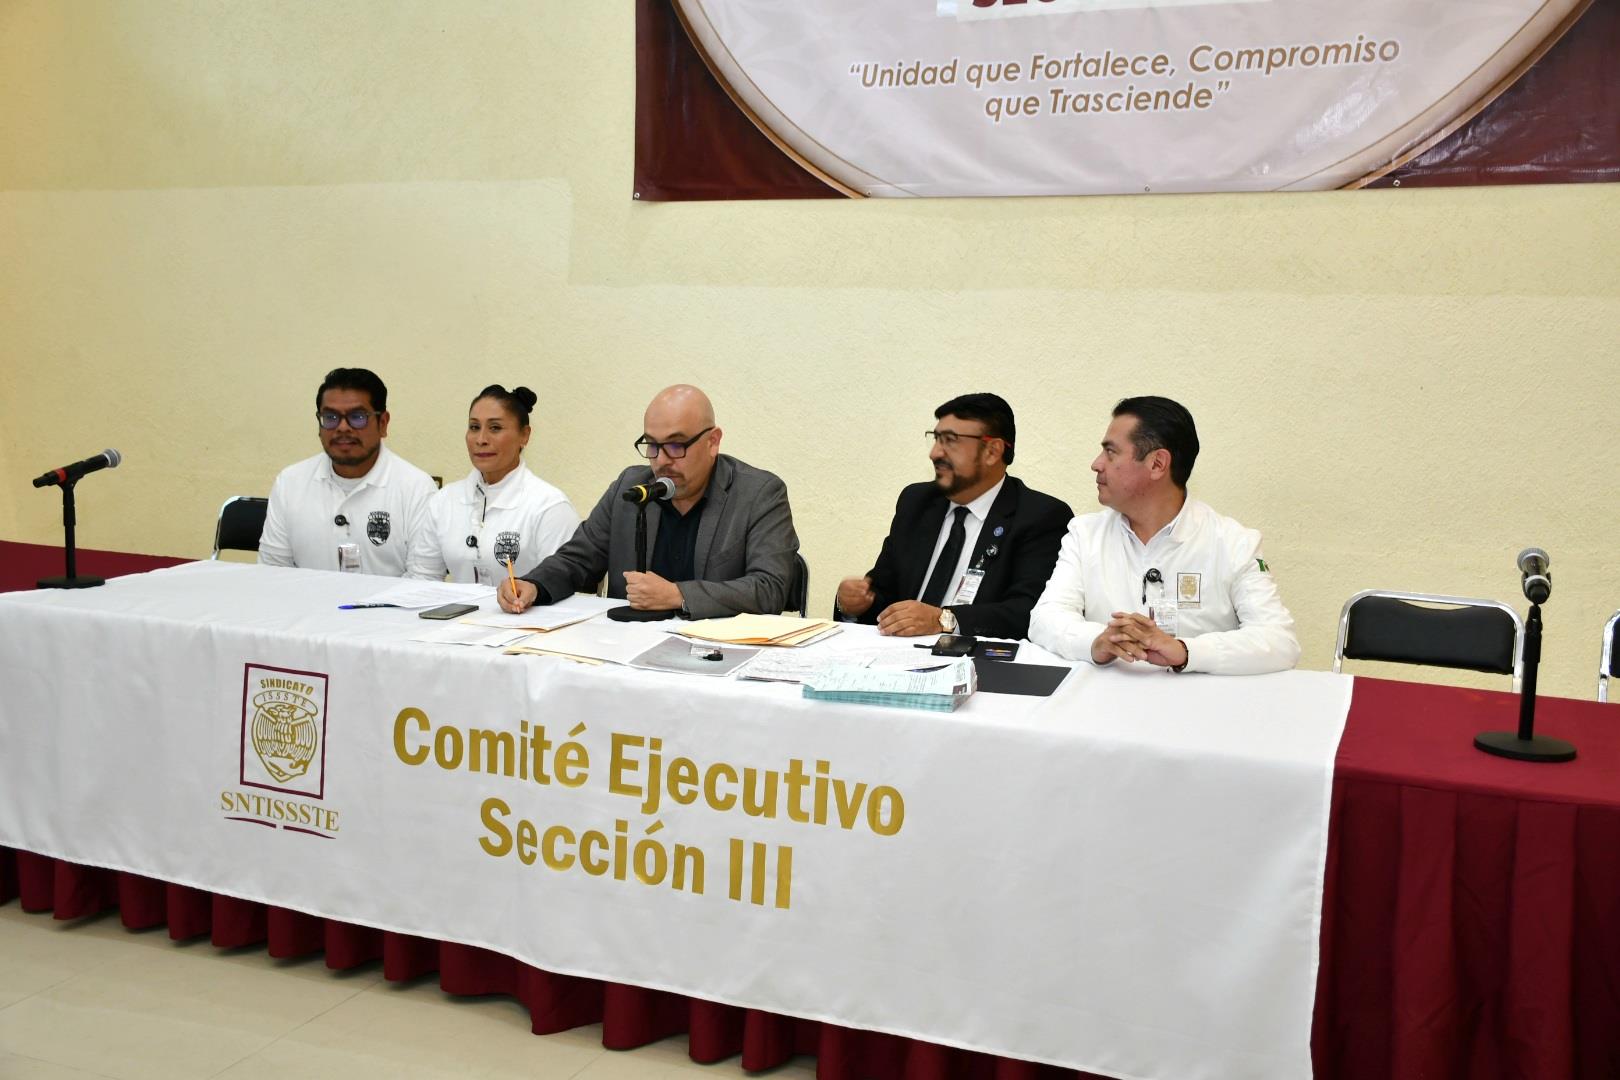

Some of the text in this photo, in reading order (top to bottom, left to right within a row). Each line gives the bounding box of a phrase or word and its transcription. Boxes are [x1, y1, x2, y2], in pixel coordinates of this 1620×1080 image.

[849, 34, 1400, 89] “Unidad que Fortalece, Compromiso
[985, 80, 1230, 122] que Trasciende”
[260, 678, 314, 696] SINDICATO
[262, 690, 308, 707] ISSSTE
[393, 707, 905, 836] Comité Ejecutivo
[221, 791, 340, 832] SNTISSSTE
[479, 797, 793, 910] Sección III
